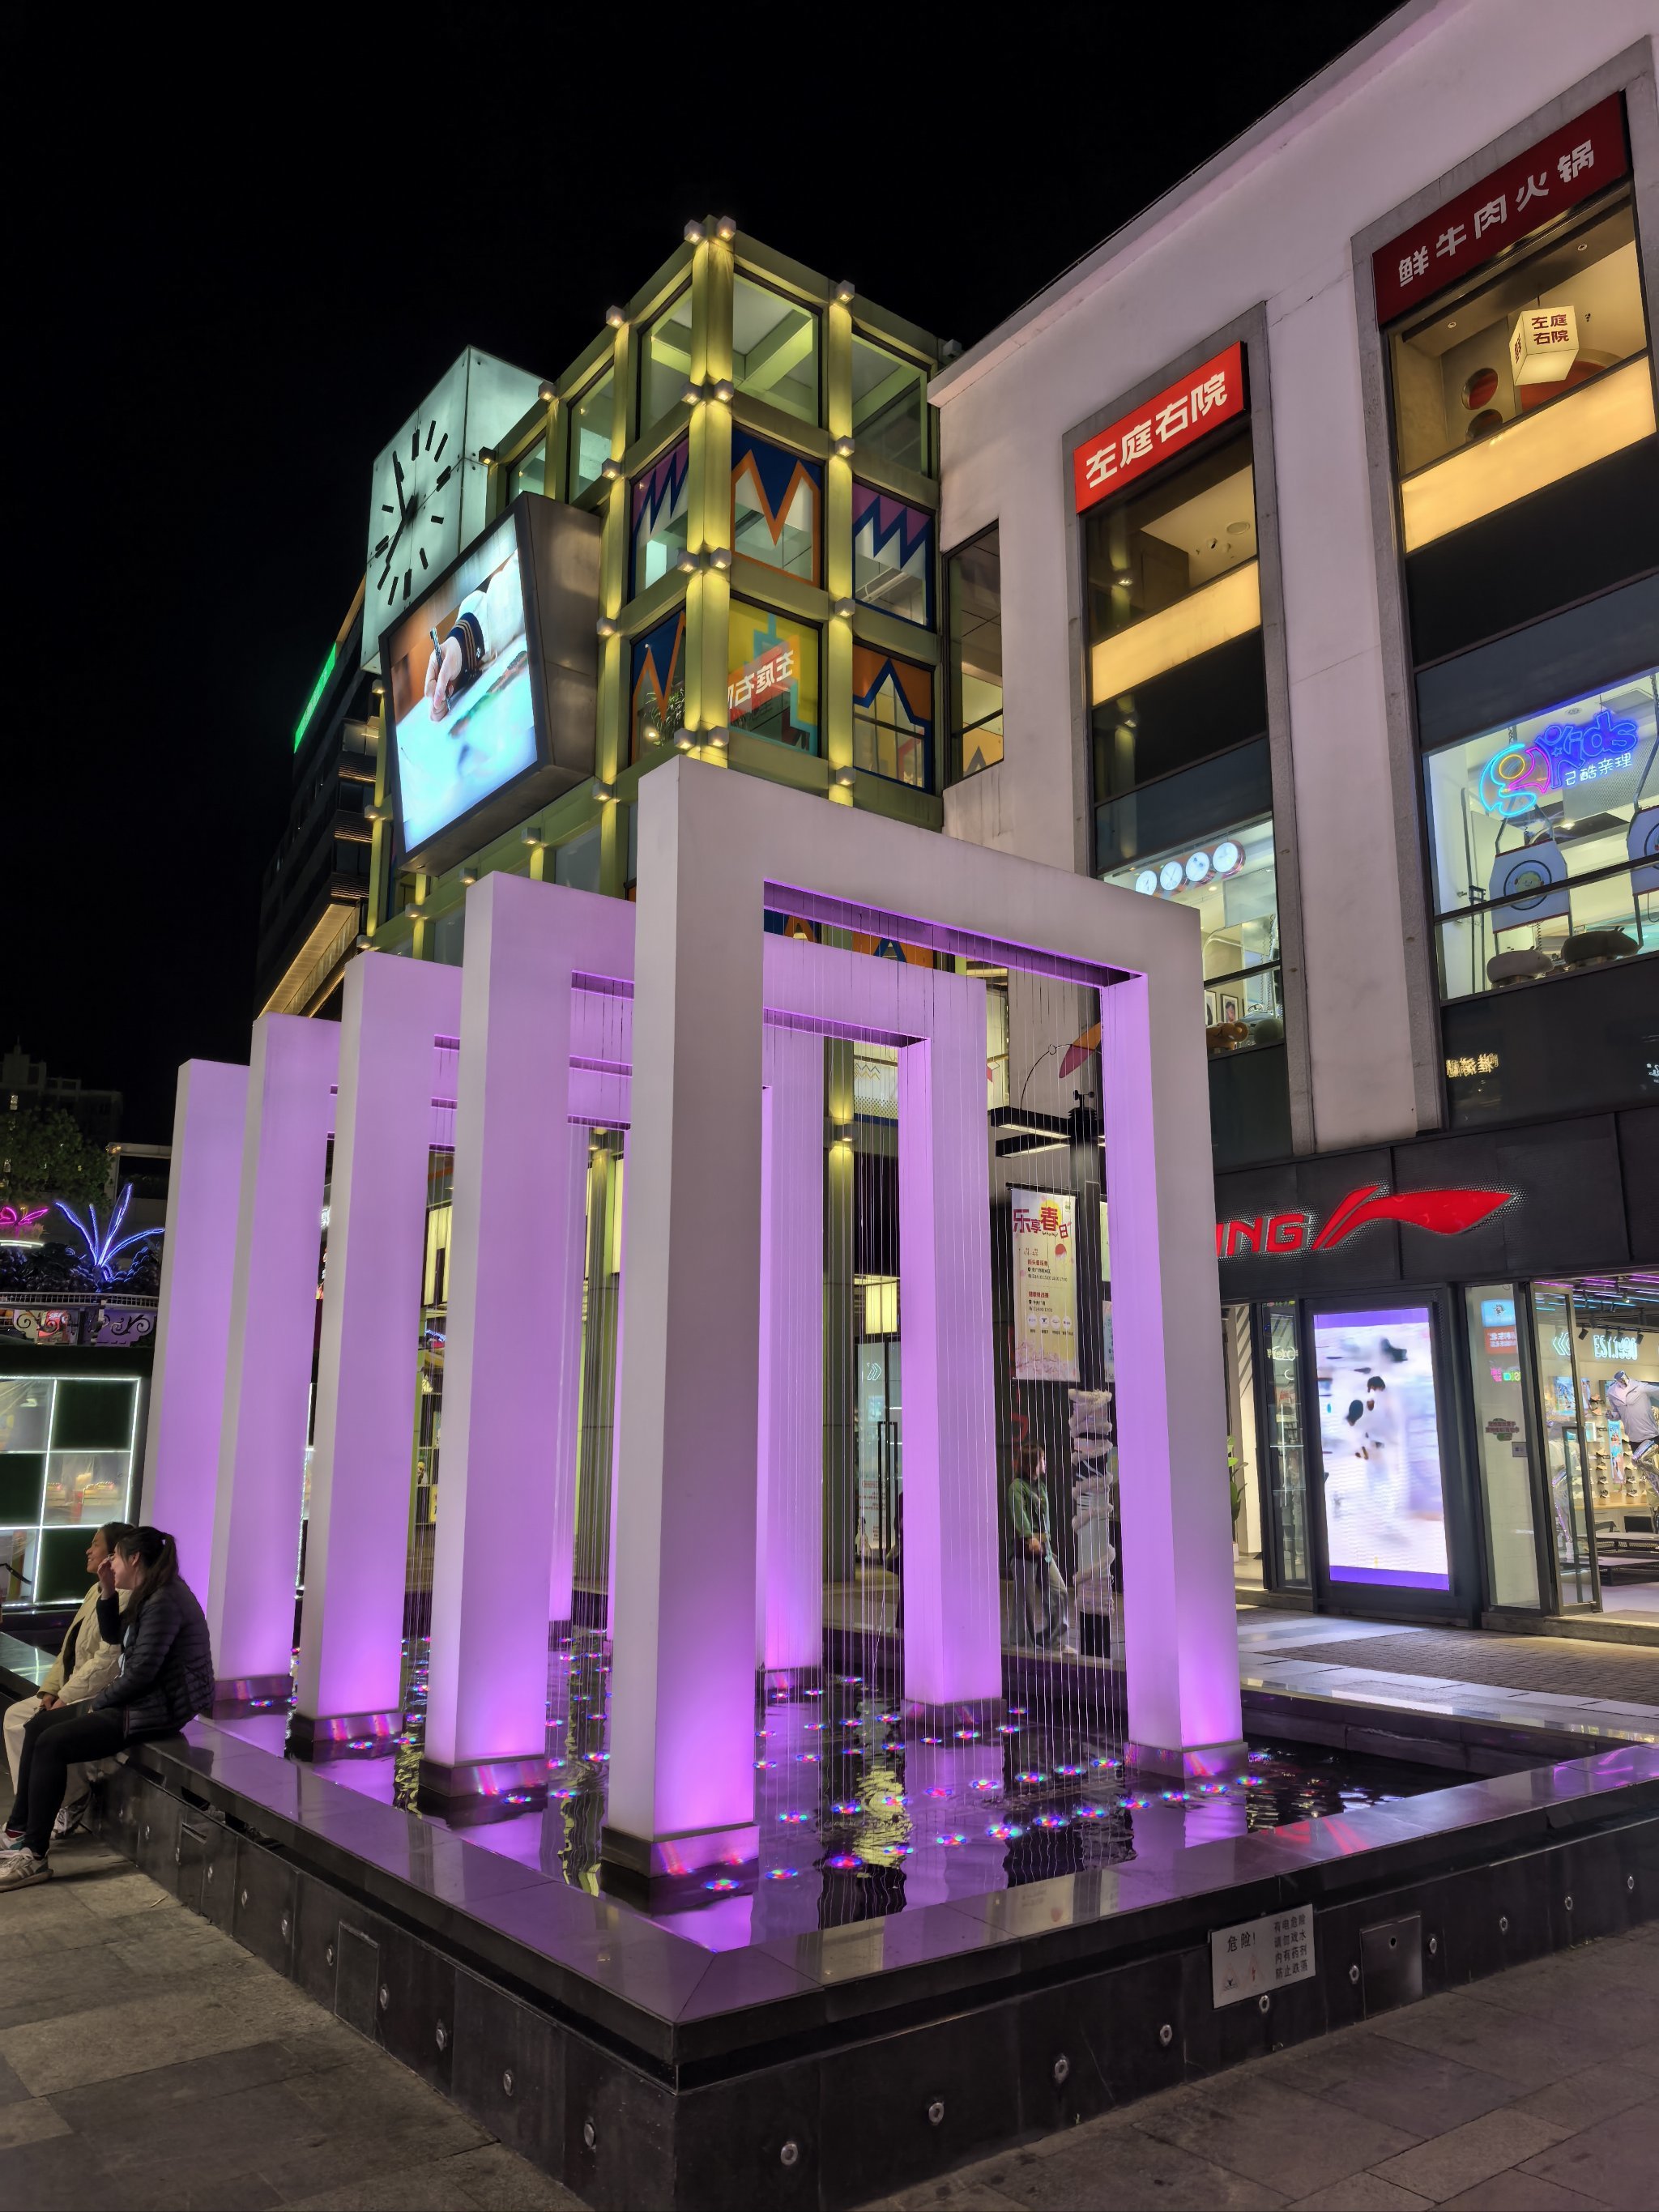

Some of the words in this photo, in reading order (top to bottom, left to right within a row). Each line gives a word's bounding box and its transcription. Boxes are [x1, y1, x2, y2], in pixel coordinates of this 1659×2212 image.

[1398, 139, 1595, 288] 鲜牛肉火锅
[1531, 313, 1568, 330] 左庭
[1533, 329, 1570, 346] 右院
[1085, 371, 1228, 489] 左庭右院
[1013, 1206, 1069, 1239] 乐享春日
